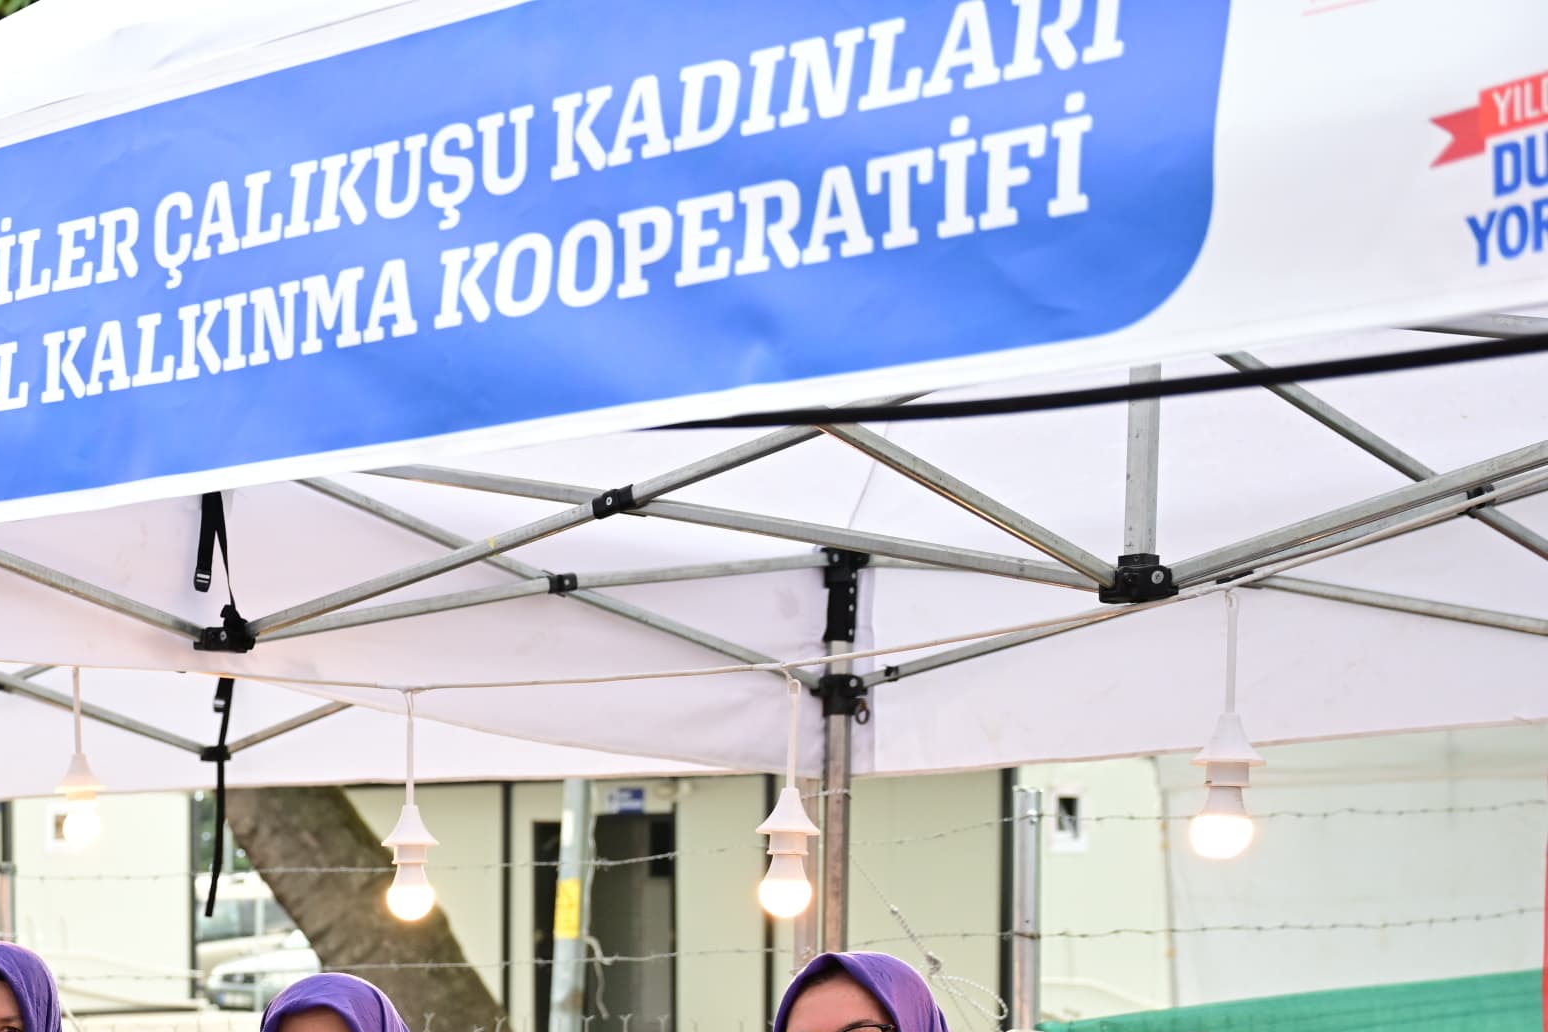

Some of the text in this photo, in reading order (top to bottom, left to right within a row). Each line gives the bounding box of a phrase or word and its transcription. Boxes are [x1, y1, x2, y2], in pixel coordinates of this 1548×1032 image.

[40, 258, 418, 403] KALKINMA
[433, 91, 1093, 330] KOOPERATİFİ
[153, 104, 535, 290] ÇALIKUŞU
[550, 0, 1125, 181] KADINLARI
